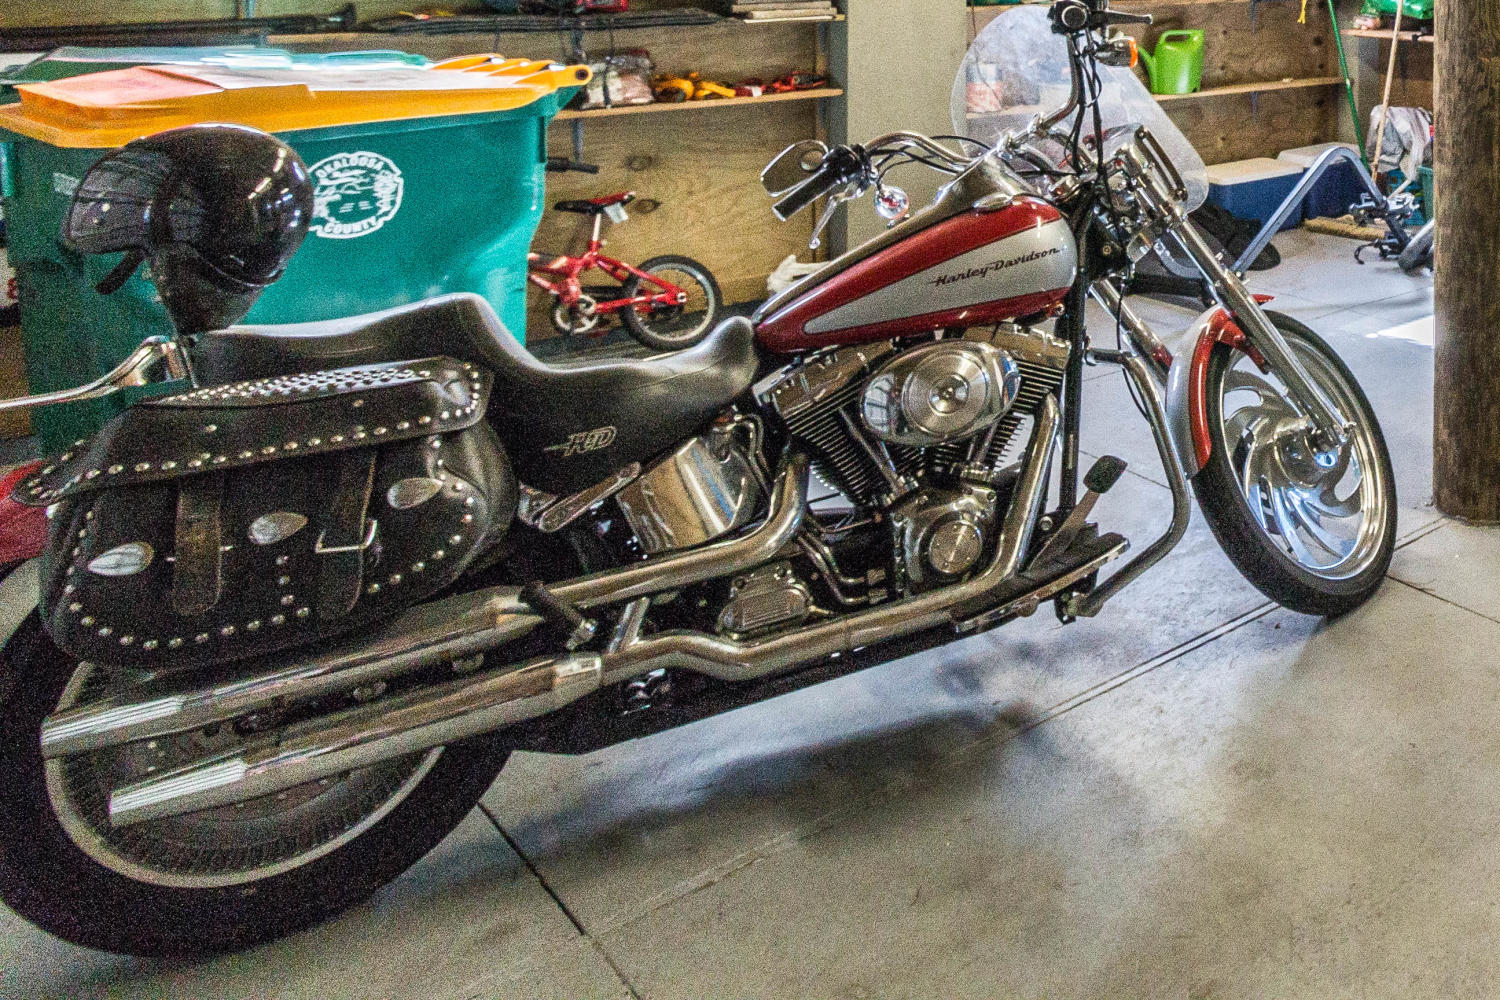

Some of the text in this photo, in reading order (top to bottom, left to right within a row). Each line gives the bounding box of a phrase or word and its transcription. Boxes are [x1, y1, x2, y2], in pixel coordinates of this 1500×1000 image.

[315, 156, 385, 178] OKALOOSA
[323, 215, 377, 235] COUNTY
[927, 247, 1061, 287] Harley-Davidson
